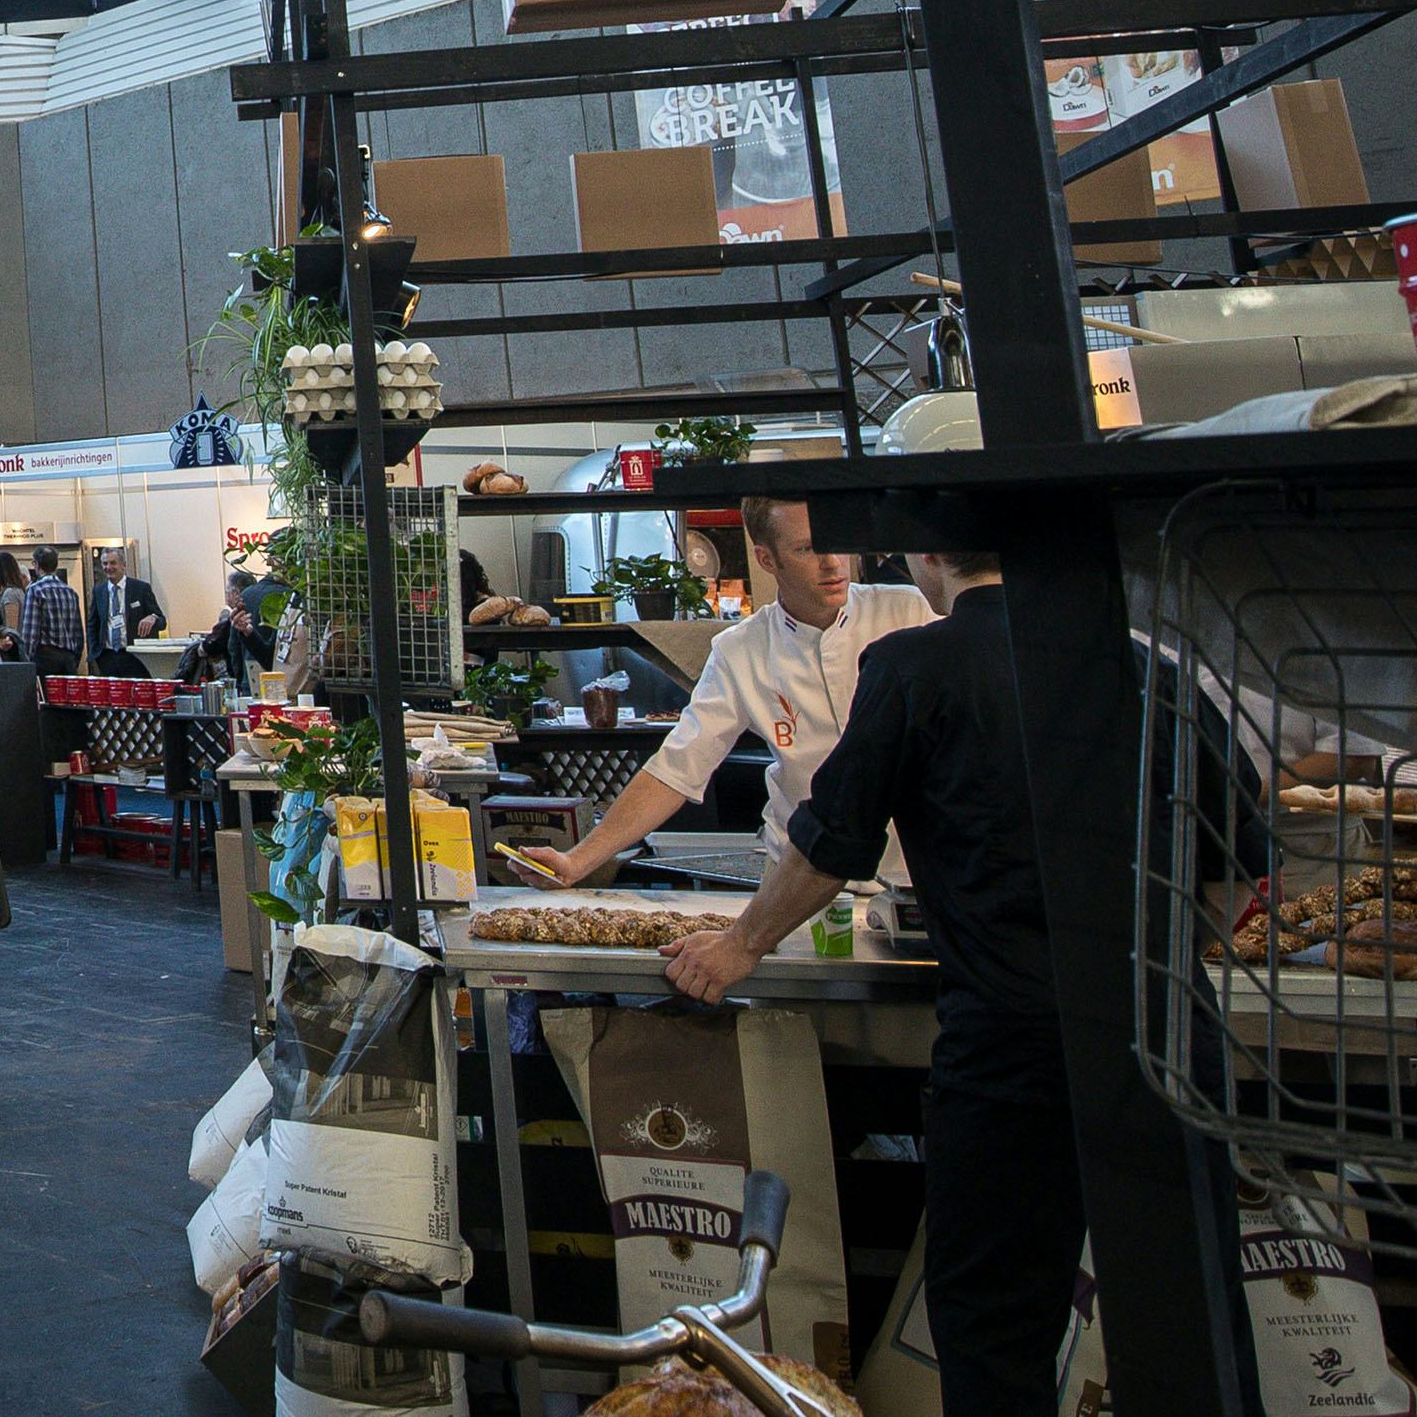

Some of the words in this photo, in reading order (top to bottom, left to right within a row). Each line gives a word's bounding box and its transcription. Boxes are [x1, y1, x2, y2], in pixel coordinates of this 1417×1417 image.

[665, 92, 800, 148] BREAK
[1092, 376, 1131, 396] ronk
[175, 411, 232, 436] KOMA
[31, 452, 113, 469] bakkerijinrichtingen
[226, 527, 270, 554] Spro
[505, 812, 549, 824] MAESTRO
[649, 1166, 695, 1180] QUALITE
[625, 1201, 732, 1239] MAESTRO
[649, 1269, 724, 1288] MEESTERLIJKE
[660, 1282, 714, 1299] KWALITEIT
[1265, 1312, 1358, 1327] MEESTERLIJKE
[1281, 1325, 1353, 1338] KWALITEIT
[1308, 1392, 1377, 1408] Zeelandia
